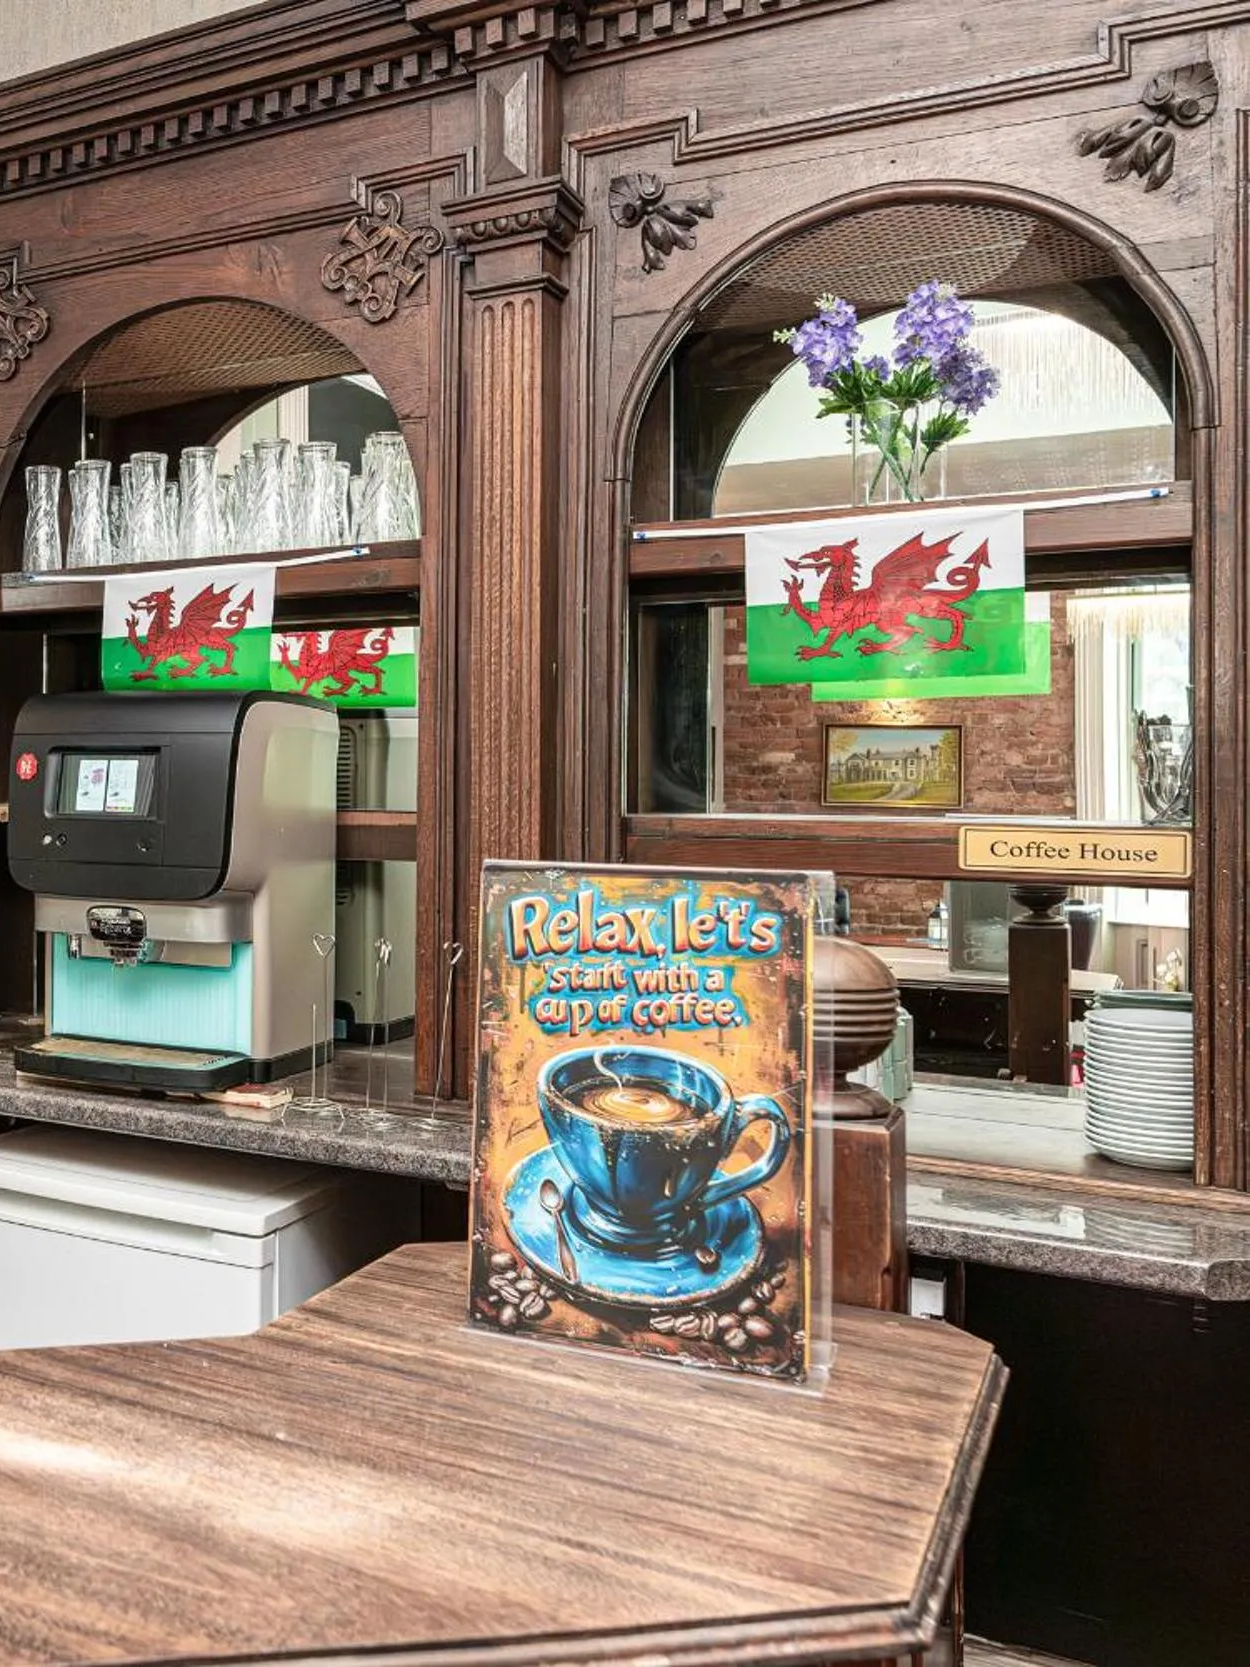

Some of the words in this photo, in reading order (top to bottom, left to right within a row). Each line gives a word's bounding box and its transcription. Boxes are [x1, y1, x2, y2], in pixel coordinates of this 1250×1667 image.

[990, 840, 1070, 859] Coffee
[1079, 843, 1158, 863] House
[510, 889, 666, 959] Relax,
[632, 961, 699, 994] with
[704, 969, 725, 992] a
[535, 998, 594, 1036] cup
[597, 995, 628, 1023] of
[632, 993, 742, 1027] coffee.
